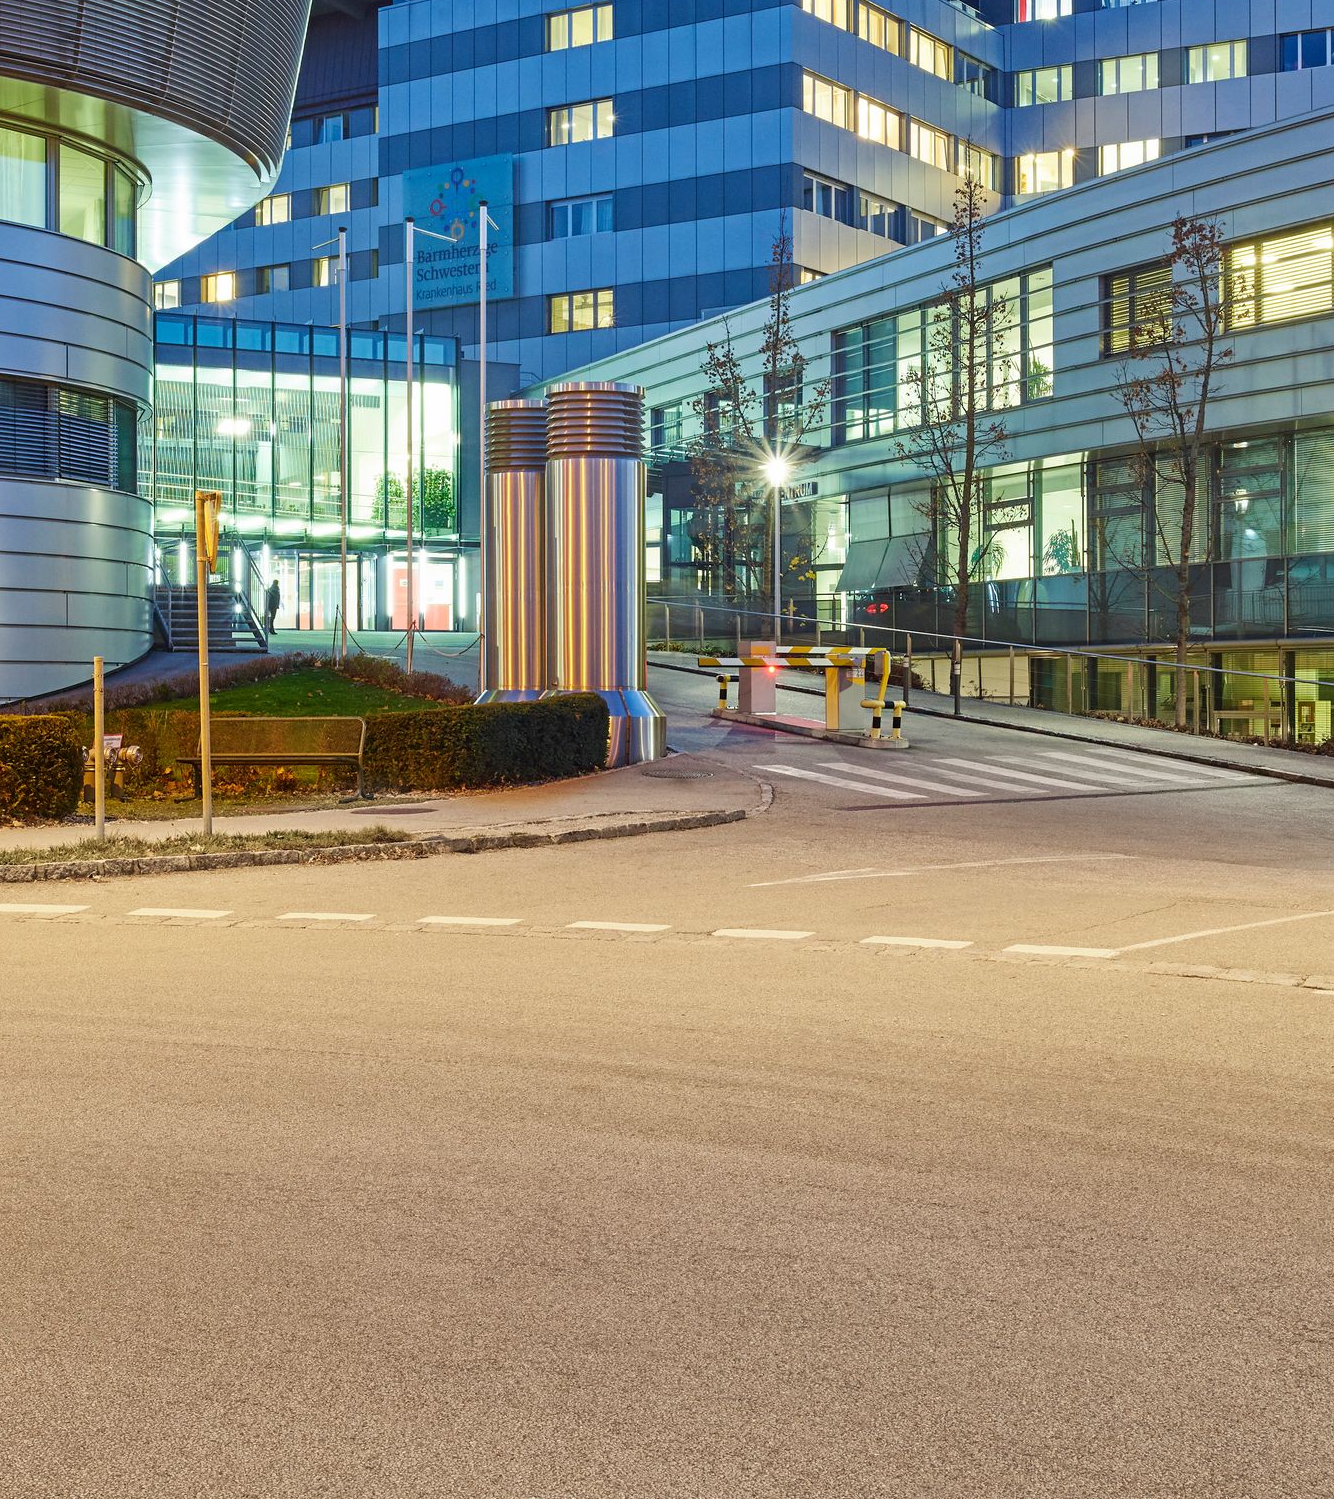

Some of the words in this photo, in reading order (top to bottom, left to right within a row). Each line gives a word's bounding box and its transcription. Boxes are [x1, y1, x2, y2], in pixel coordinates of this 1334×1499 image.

[417, 242, 498, 264] Barmherzge
[416, 284, 473, 300] Krankenhaus
[475, 279, 496, 293] Red
